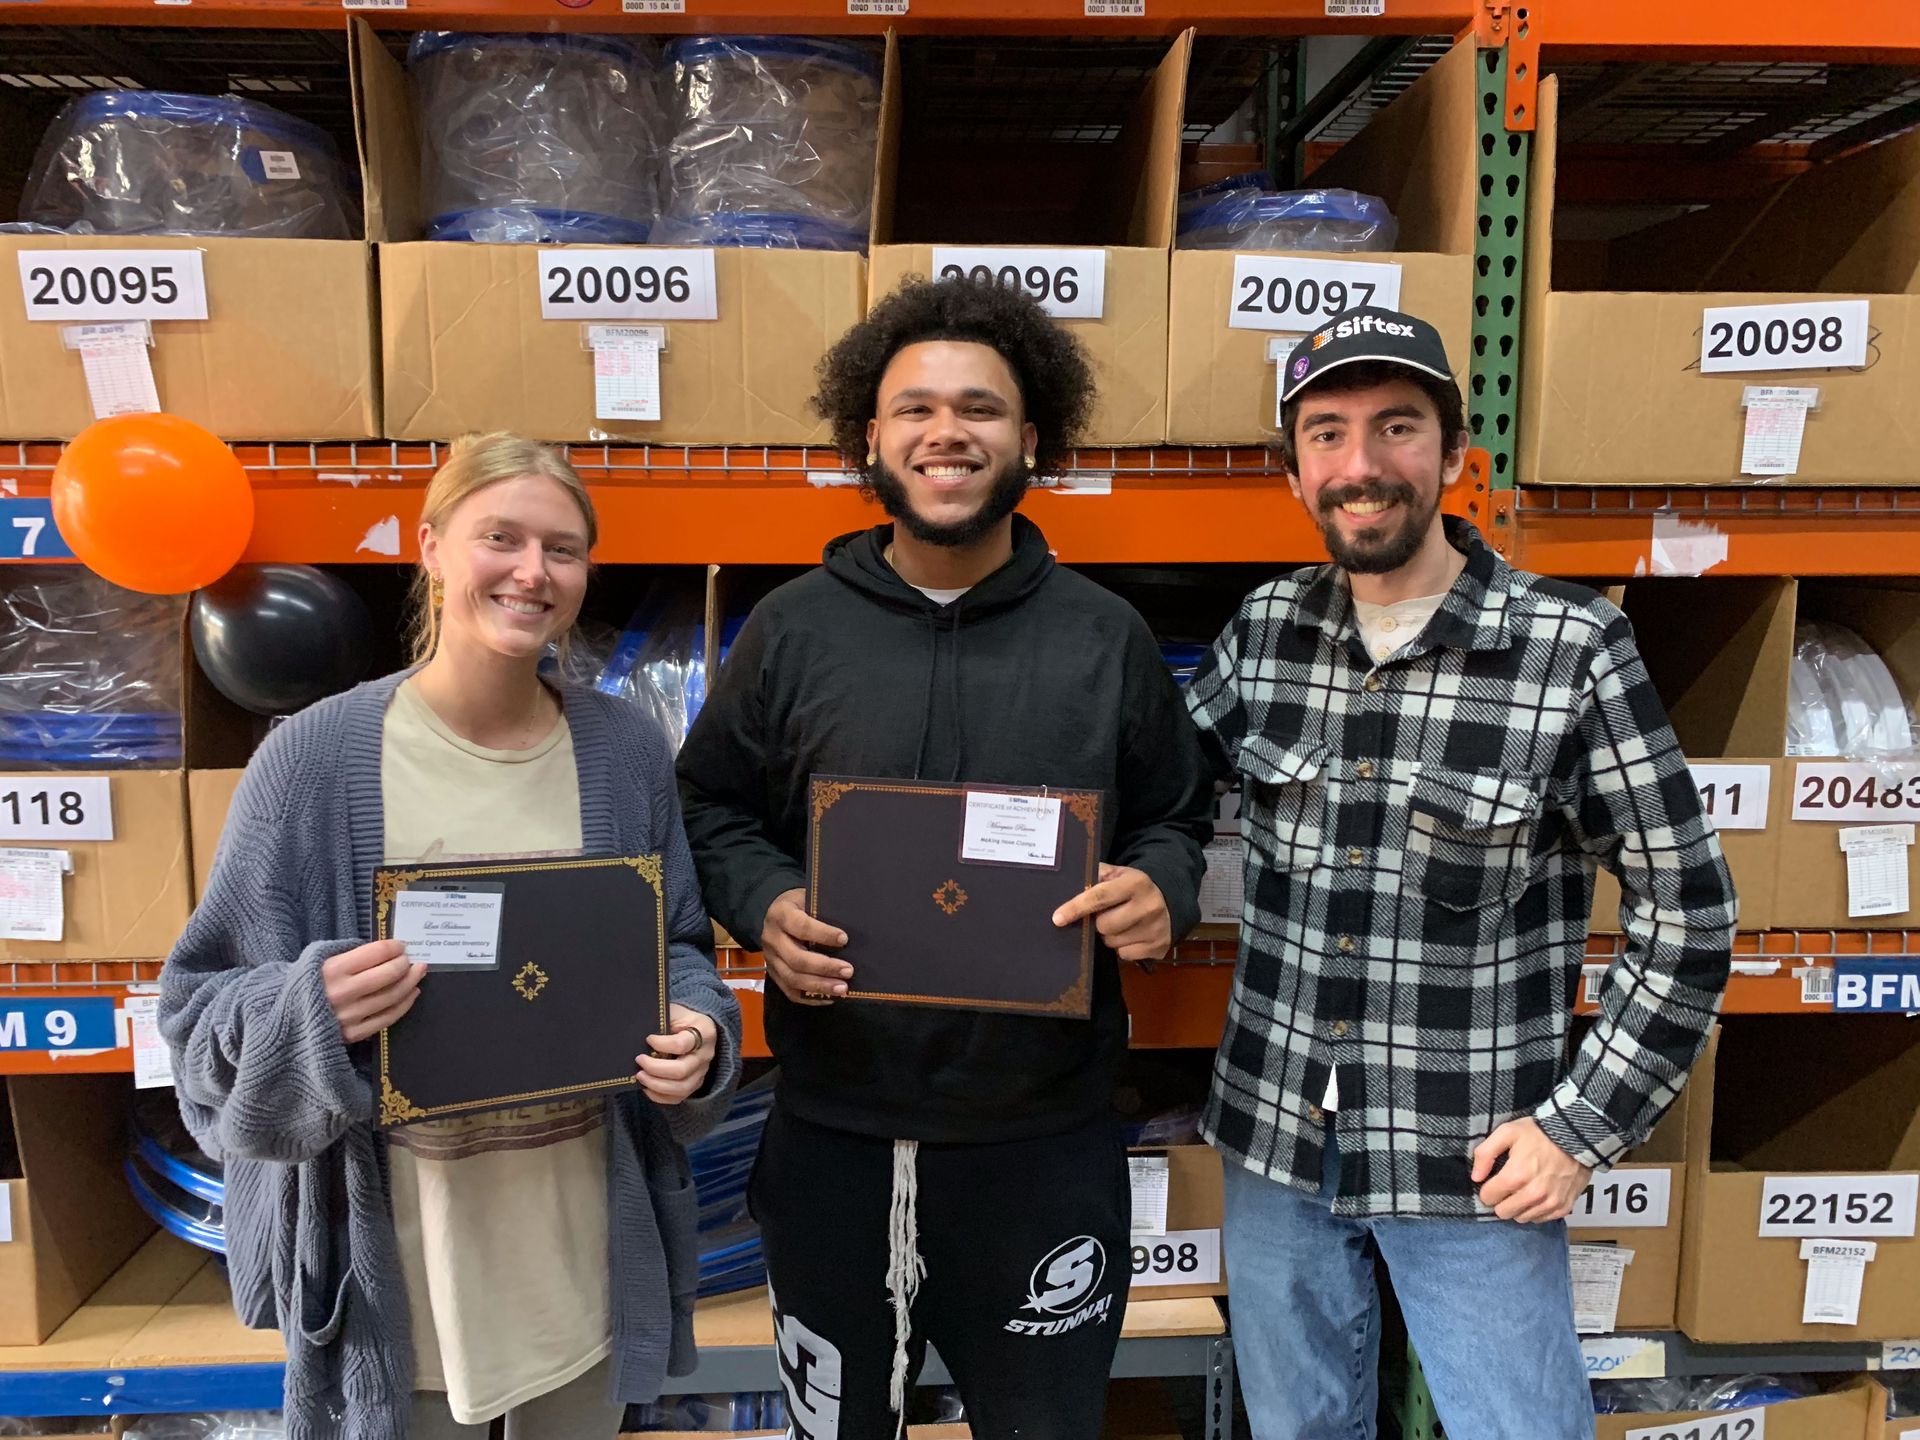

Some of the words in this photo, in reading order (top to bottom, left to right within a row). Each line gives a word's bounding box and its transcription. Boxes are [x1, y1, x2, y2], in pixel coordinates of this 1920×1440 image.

[1110, 5, 1118, 13] 15
[1121, 5, 1130, 13] 04
[29, 266, 178, 305] 20095
[548, 265, 691, 304] 20096
[1237, 275, 1376, 317] 20097
[1335, 315, 1416, 339] Siftex
[1708, 316, 1843, 359] 20098
[12, 516, 46, 556] 7
[1, 790, 85, 826] 118
[44, 1009, 78, 1047] 9
[1569, 1182, 1649, 1215] 116
[1766, 1192, 1894, 1225] 22152
[1131, 1242, 1199, 1275] 998
[1812, 1245, 1867, 1257] BFM22152
